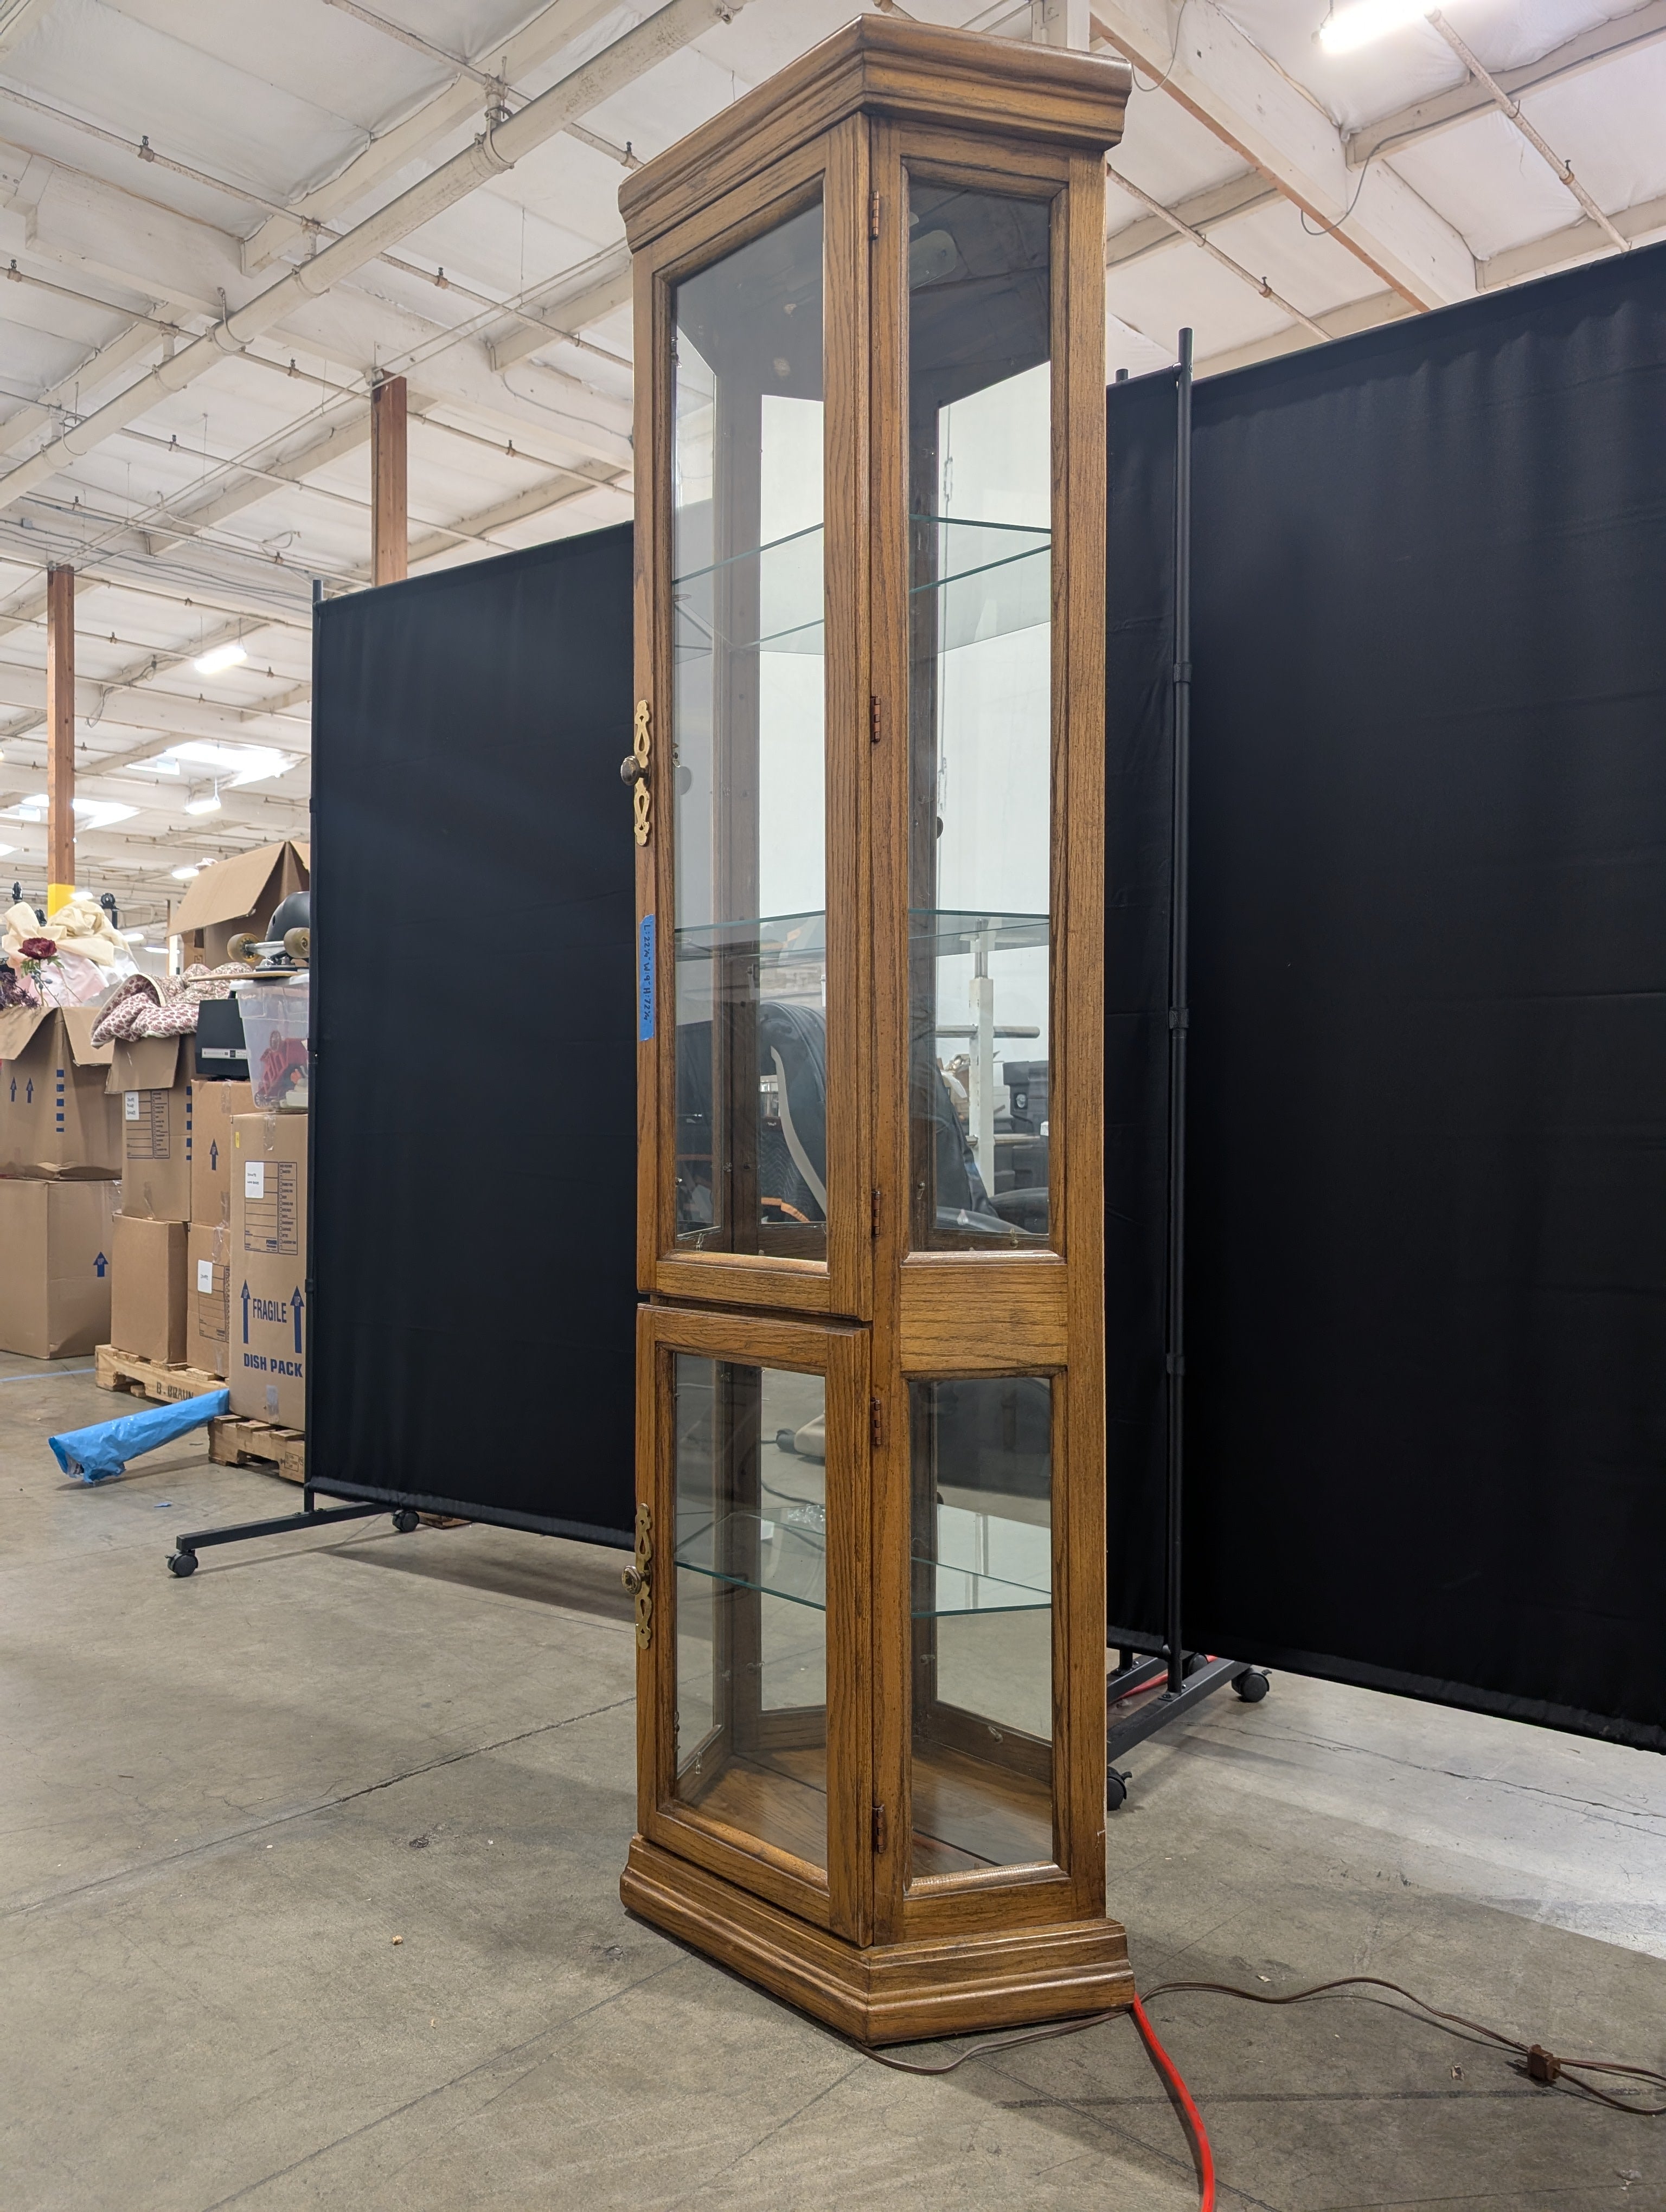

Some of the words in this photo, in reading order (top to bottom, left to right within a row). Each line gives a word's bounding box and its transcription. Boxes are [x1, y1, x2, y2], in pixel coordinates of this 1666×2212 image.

[253, 1298, 287, 1323] FRAGILE
[294, 1296, 300, 1306] UP
[244, 1353, 267, 1371] DISH
[270, 1358, 303, 1378] PACK
